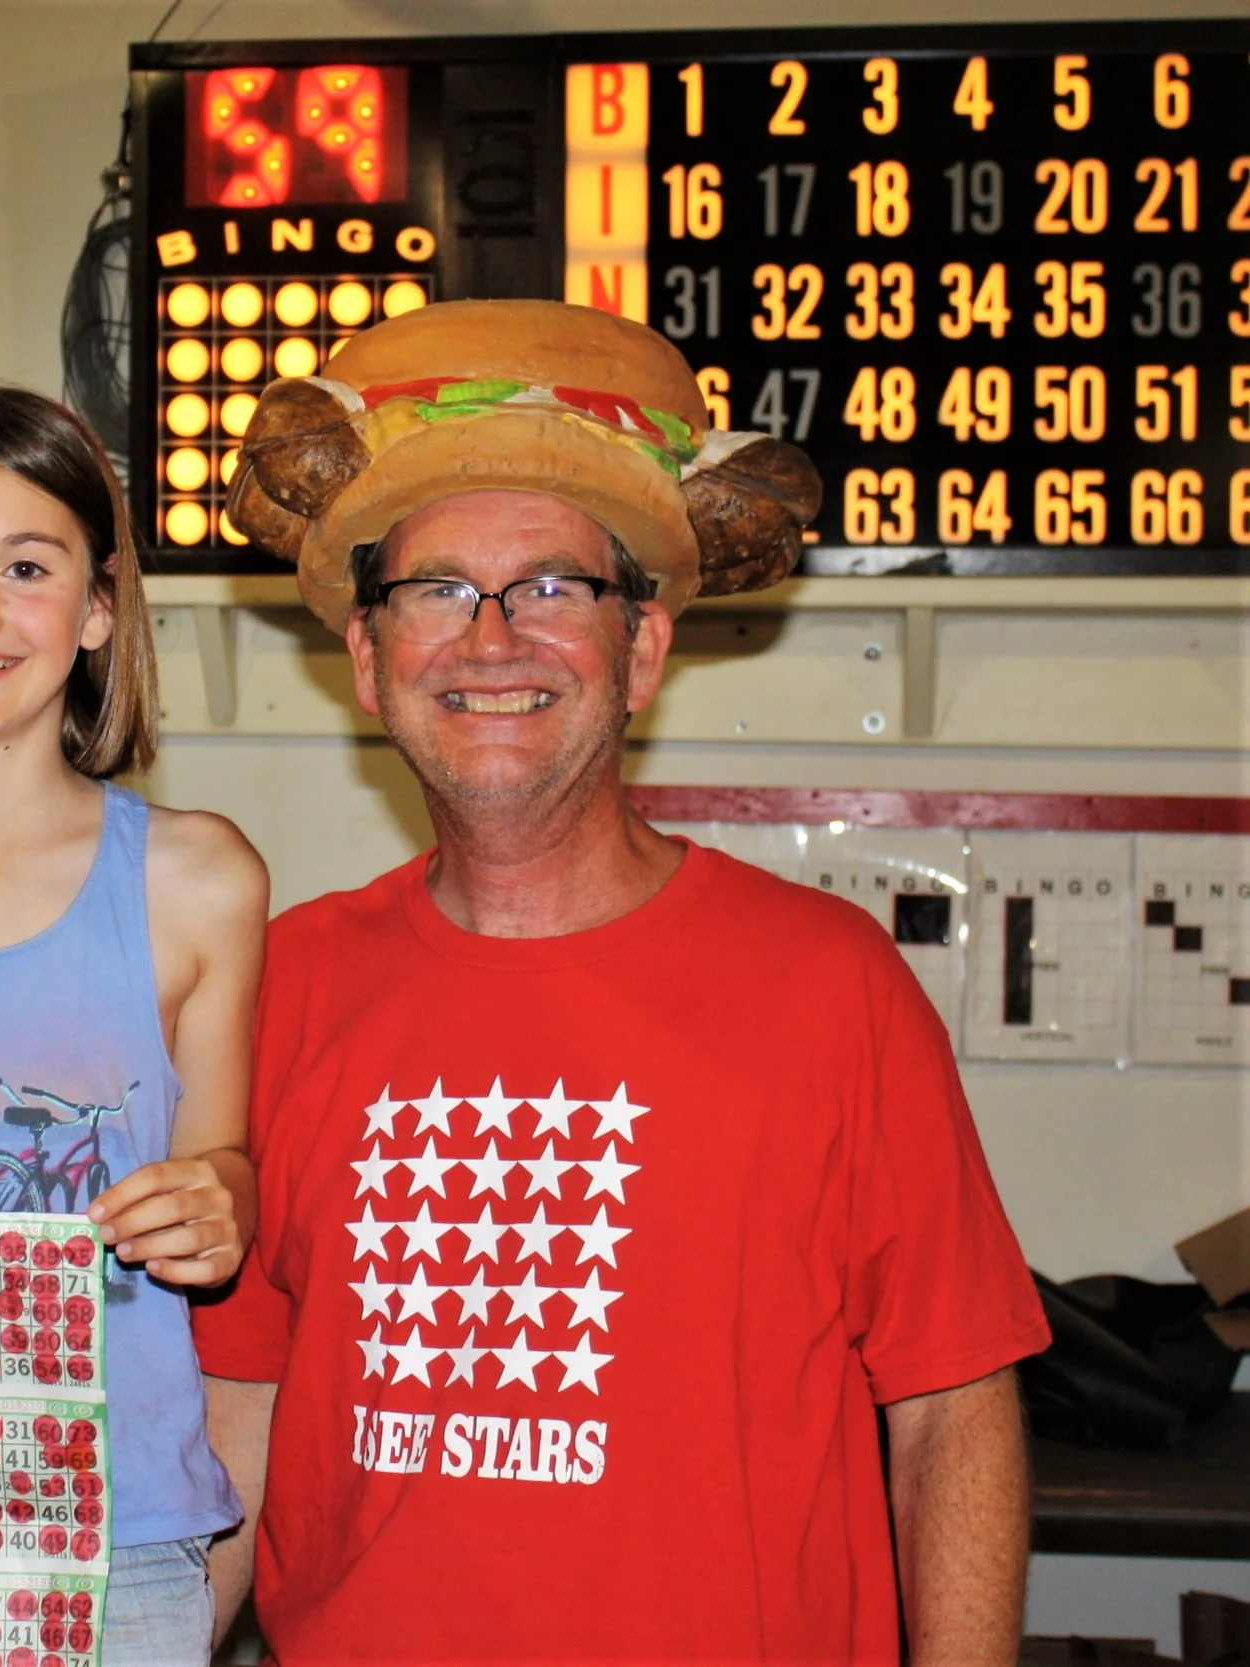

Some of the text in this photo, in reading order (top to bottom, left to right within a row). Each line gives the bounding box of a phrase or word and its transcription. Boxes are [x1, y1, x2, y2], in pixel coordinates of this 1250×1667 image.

[591, 53, 1190, 136] B 1 2 3 4 5 6
[663, 163, 723, 239] 16
[759, 164, 815, 235] 17
[849, 160, 910, 237] 18
[946, 161, 1002, 233] 19
[1035, 159, 1108, 234] 20
[1134, 158, 1198, 232] 21
[1228, 156, 1250, 230] 2
[157, 219, 436, 267] BINGO
[664, 267, 720, 337] 31
[752, 264, 824, 340] 32
[846, 262, 914, 340] 33
[940, 263, 1011, 339] 34
[1034, 261, 1106, 338] 35
[1132, 264, 1201, 337] 36
[1229, 259, 1250, 337] 3
[696, 365, 1250, 442] 6 47 48 49 50 51 5
[844, 468, 1250, 544] 63 64 65 66 6
[985, 879, 1112, 896] BINGO
[1153, 882, 1250, 899] BING
[66, 1275, 90, 1294] 71
[4, 1358, 30, 1376] 36
[6, 1421, 30, 1440] 31
[440, 1413, 608, 1485] STARS
[6, 1450, 31, 1468] 41
[42, 1505, 69, 1522] 46
[10, 1531, 36, 1550] 40
[8, 1626, 33, 1645] 41
